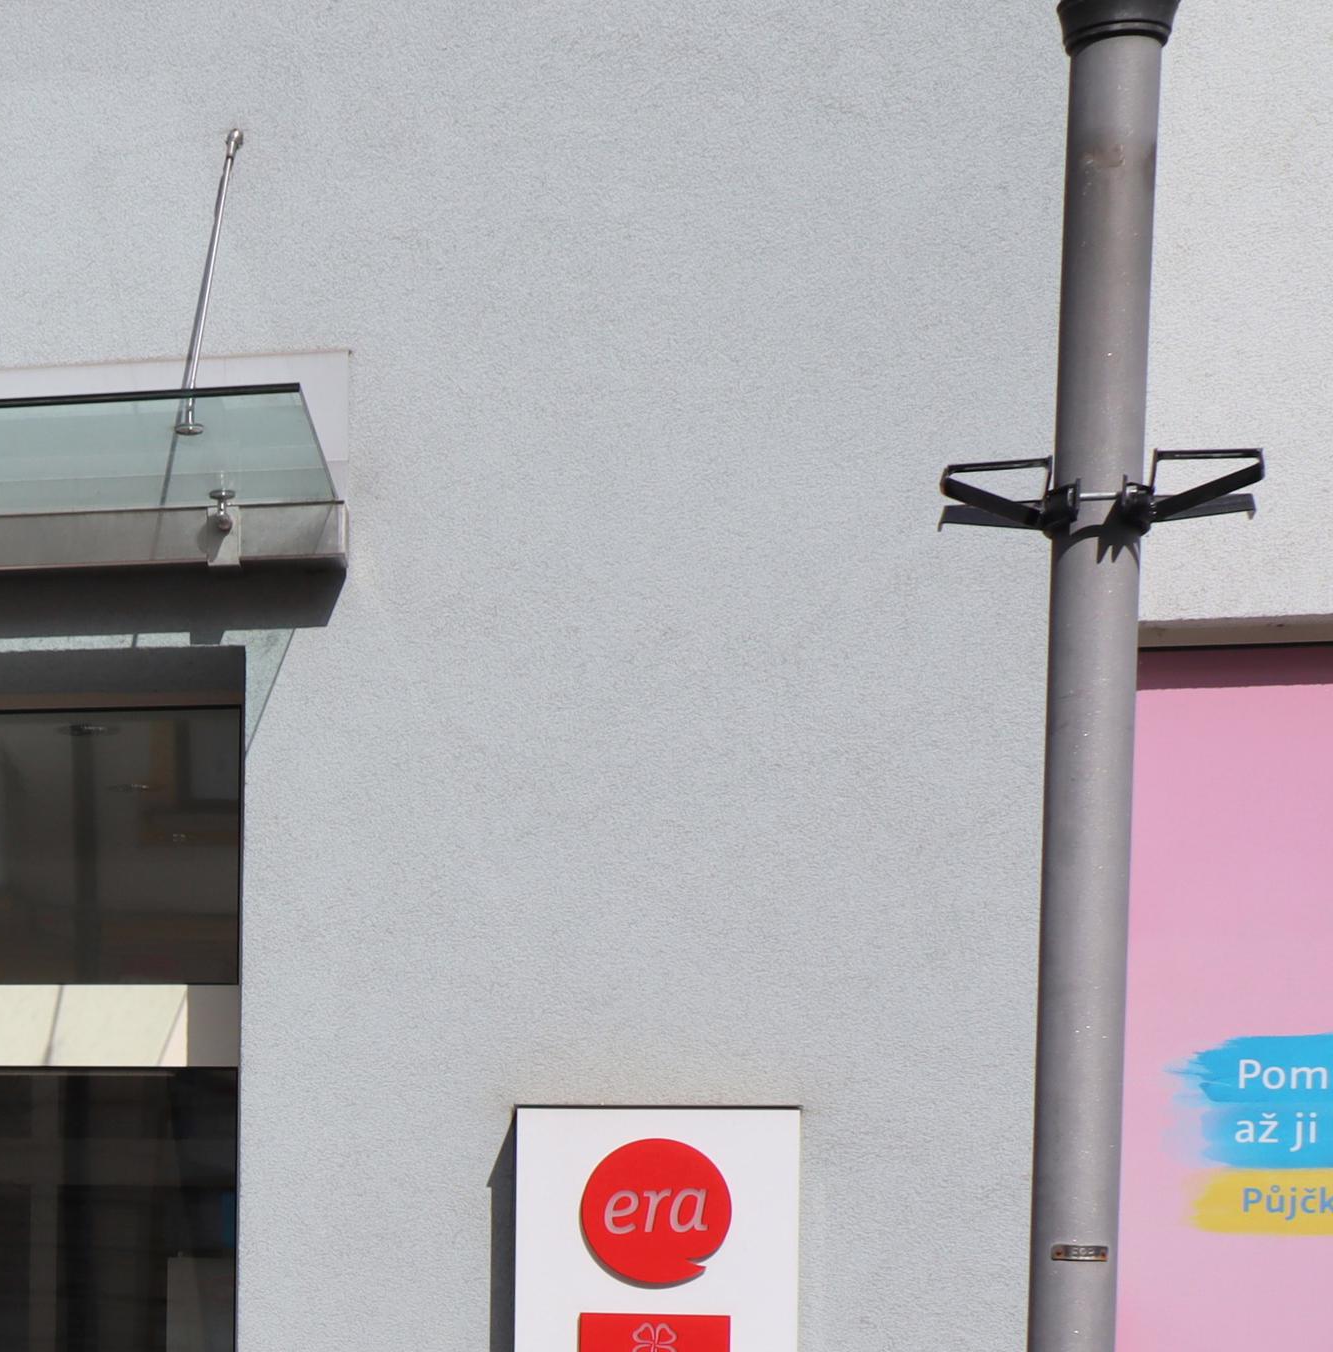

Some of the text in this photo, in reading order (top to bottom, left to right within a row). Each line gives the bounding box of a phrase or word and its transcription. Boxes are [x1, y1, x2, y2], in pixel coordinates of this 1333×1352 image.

[1238, 1059, 1328, 1089] Pom
[1234, 1112, 1318, 1152] až ji
[604, 1186, 709, 1235] era
[1242, 1185, 1333, 1221] Půjčk
